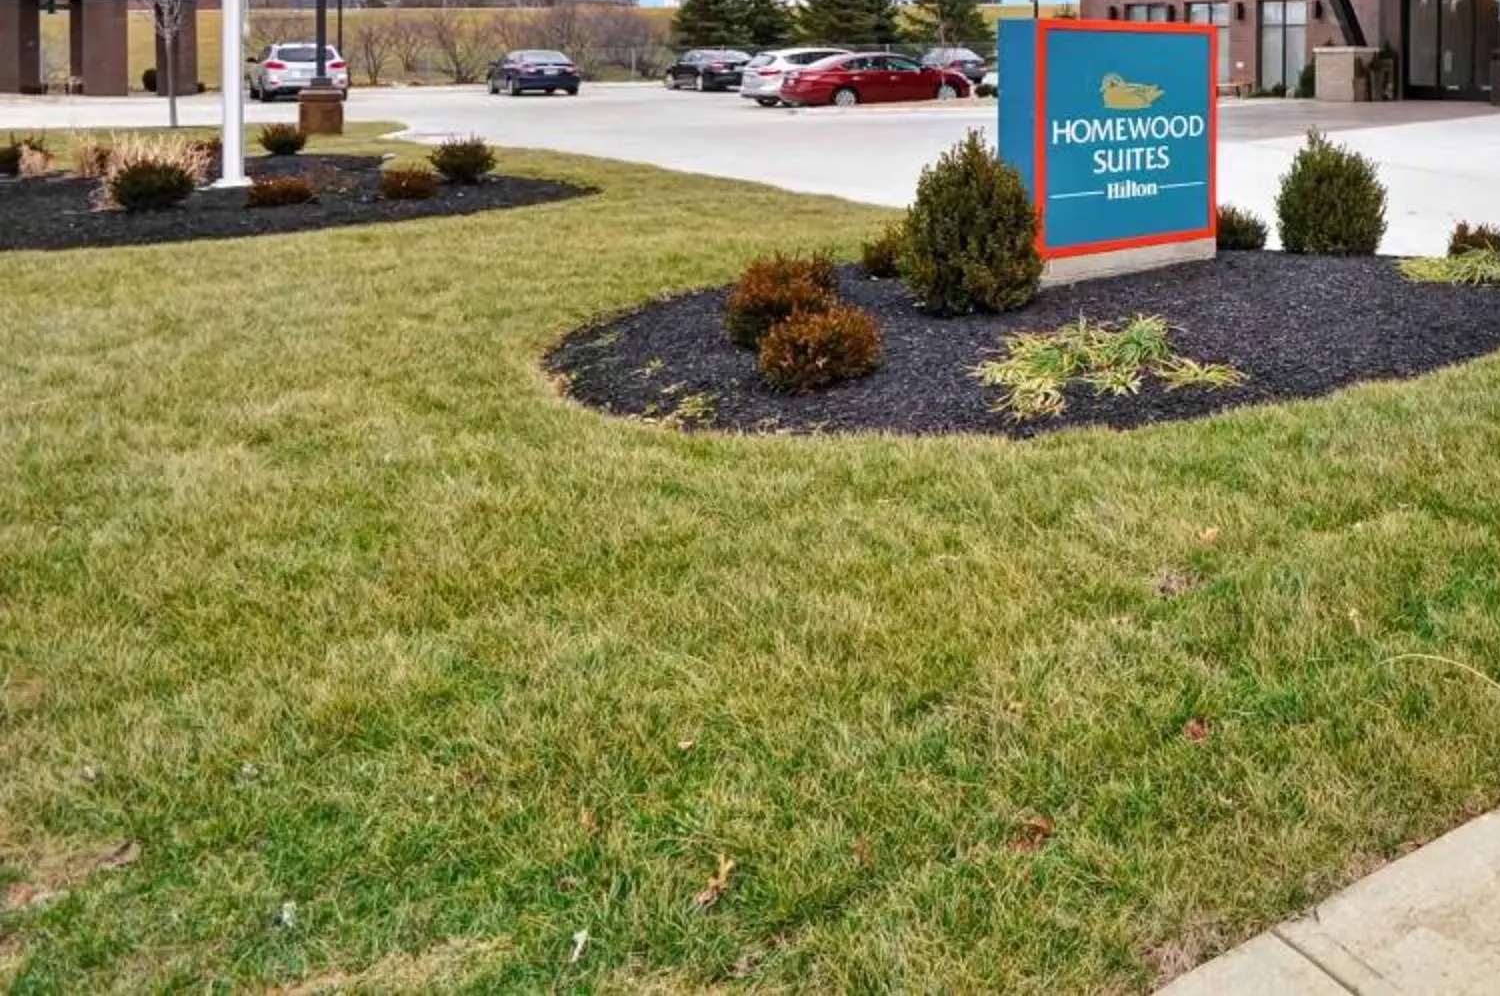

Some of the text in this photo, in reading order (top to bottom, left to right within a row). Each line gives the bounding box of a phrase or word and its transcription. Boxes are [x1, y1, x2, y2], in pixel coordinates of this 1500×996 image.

[1052, 115, 1205, 145] HOMEWOOD
[1092, 146, 1169, 174] SUITES
[1107, 180, 1158, 199] Hilton
